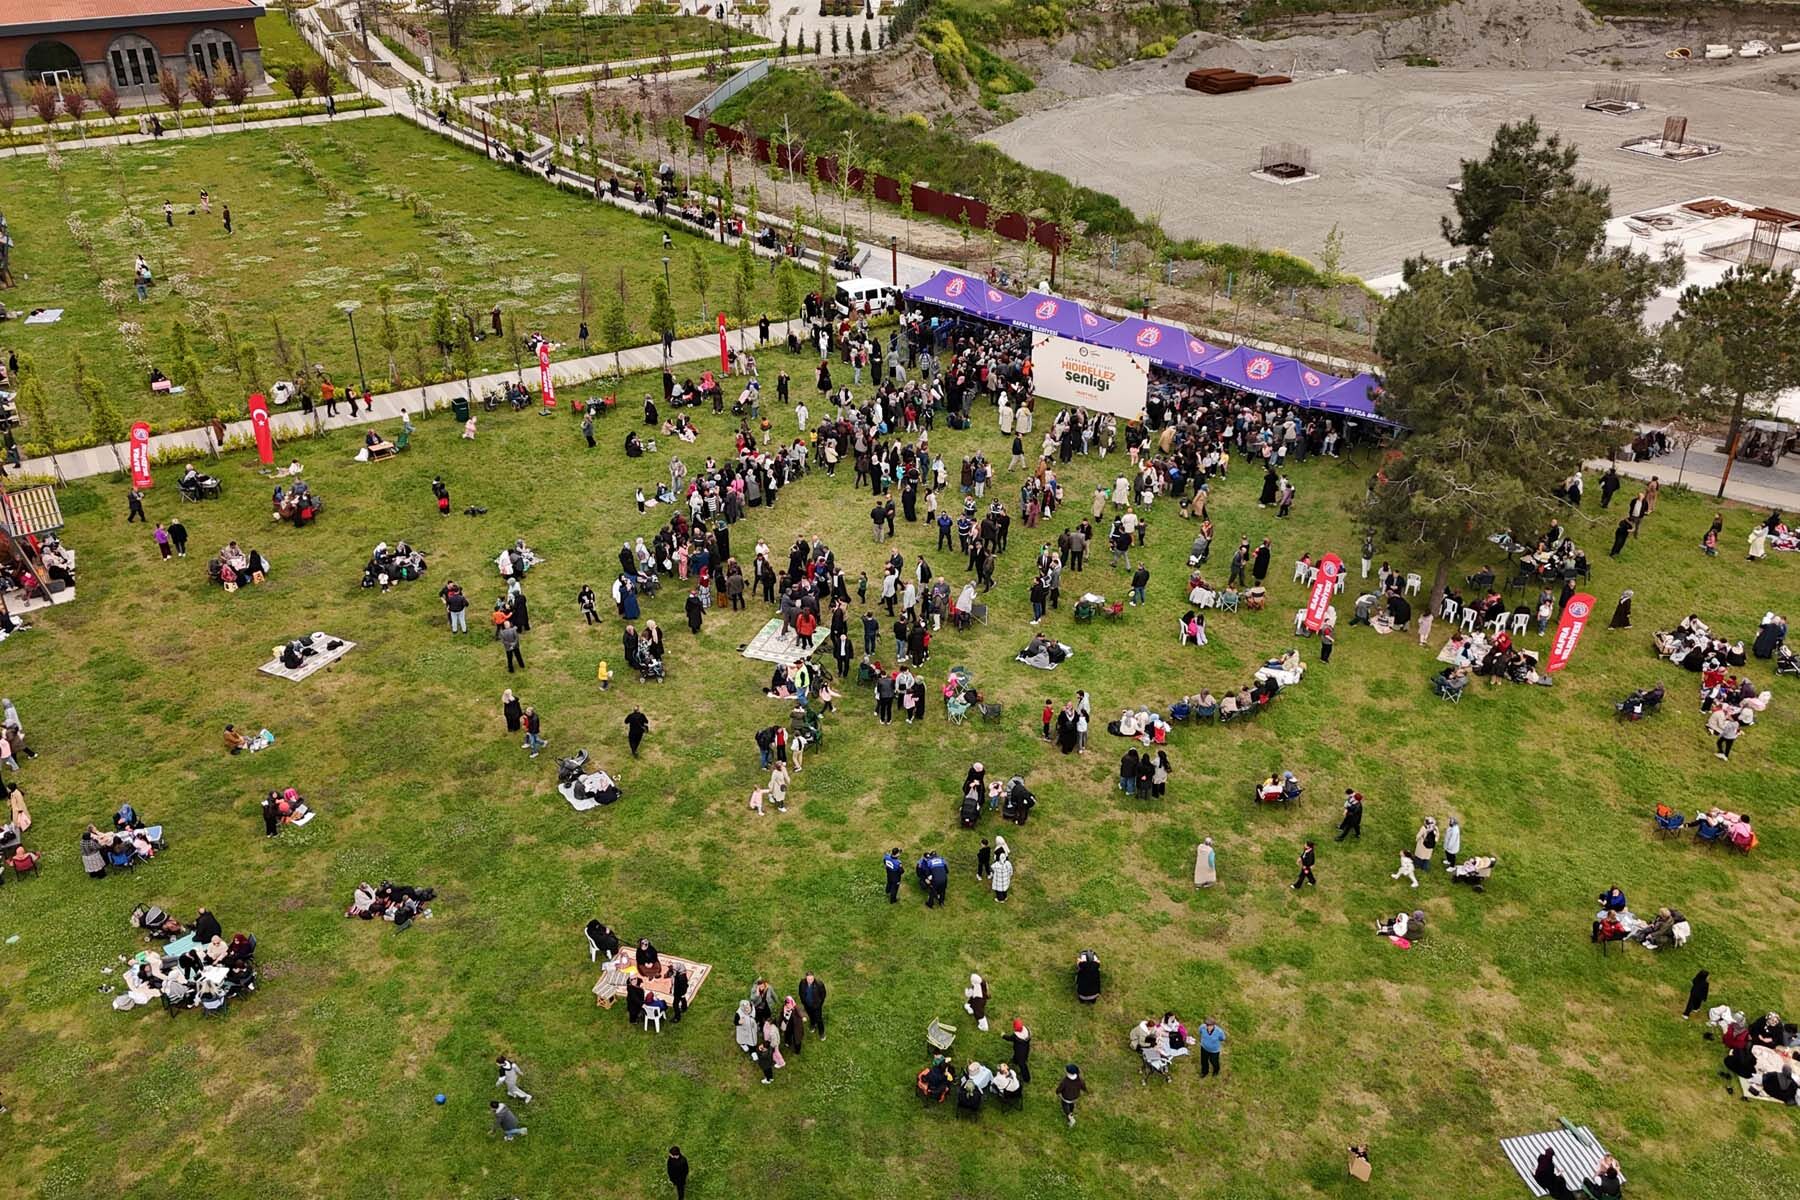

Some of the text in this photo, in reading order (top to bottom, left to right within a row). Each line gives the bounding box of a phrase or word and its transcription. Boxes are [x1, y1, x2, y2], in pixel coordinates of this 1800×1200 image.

[1061, 360, 1116, 381] HIDIRELLEZ
[1310, 583, 1324, 610] BAFRA
[1314, 580, 1333, 620] BELEDİYESİ
[1554, 626, 1572, 655] BAFRA
[1561, 621, 1584, 660] BELEDİYESİ
